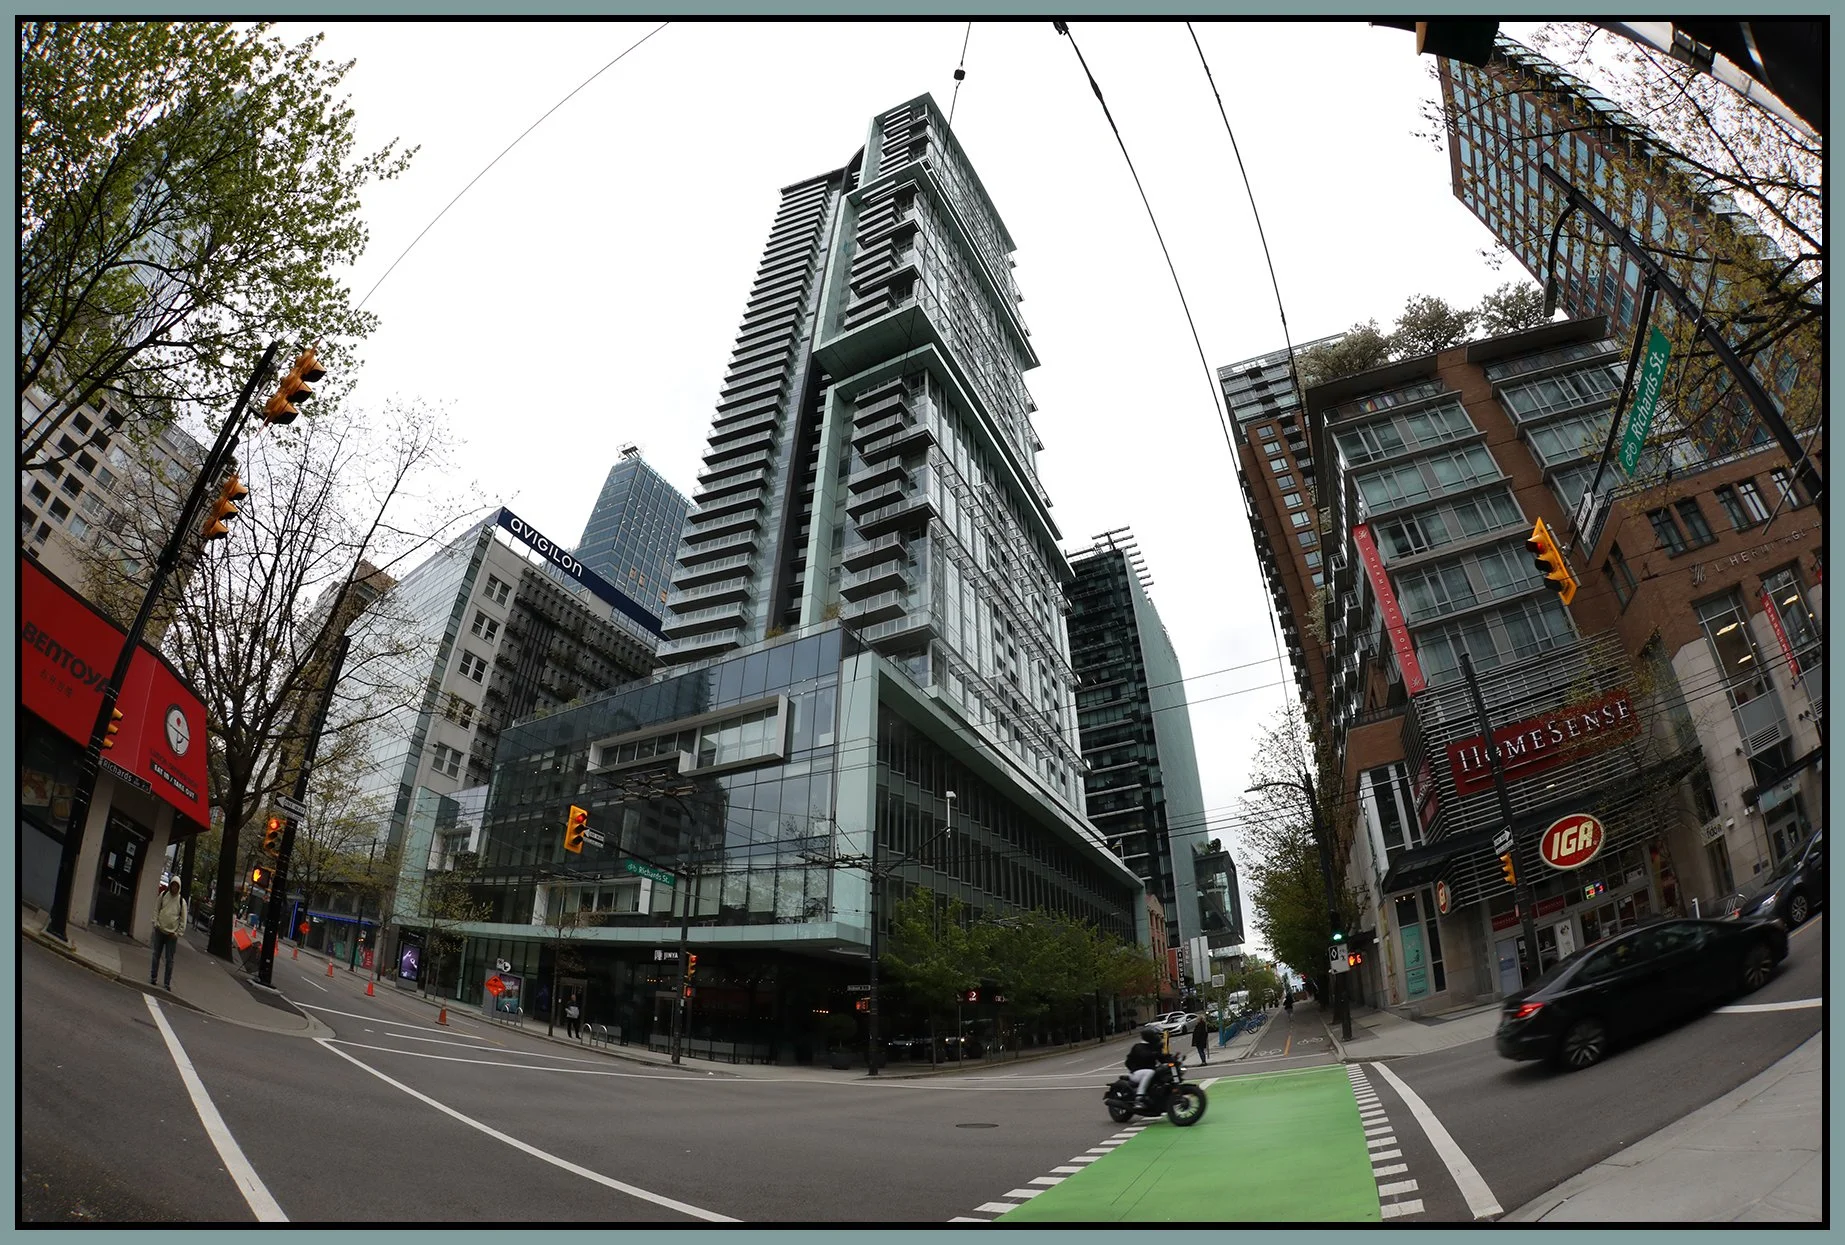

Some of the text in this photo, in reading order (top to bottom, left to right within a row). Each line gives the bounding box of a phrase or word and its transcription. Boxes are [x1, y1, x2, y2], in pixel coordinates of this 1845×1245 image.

[1631, 351, 1665, 441] Richards St.
[1459, 699, 1631, 772] HOMESENSE
[103, 760, 132, 782] Richards
[1551, 820, 1593, 861] IGA
[638, 866, 662, 881] Richards
